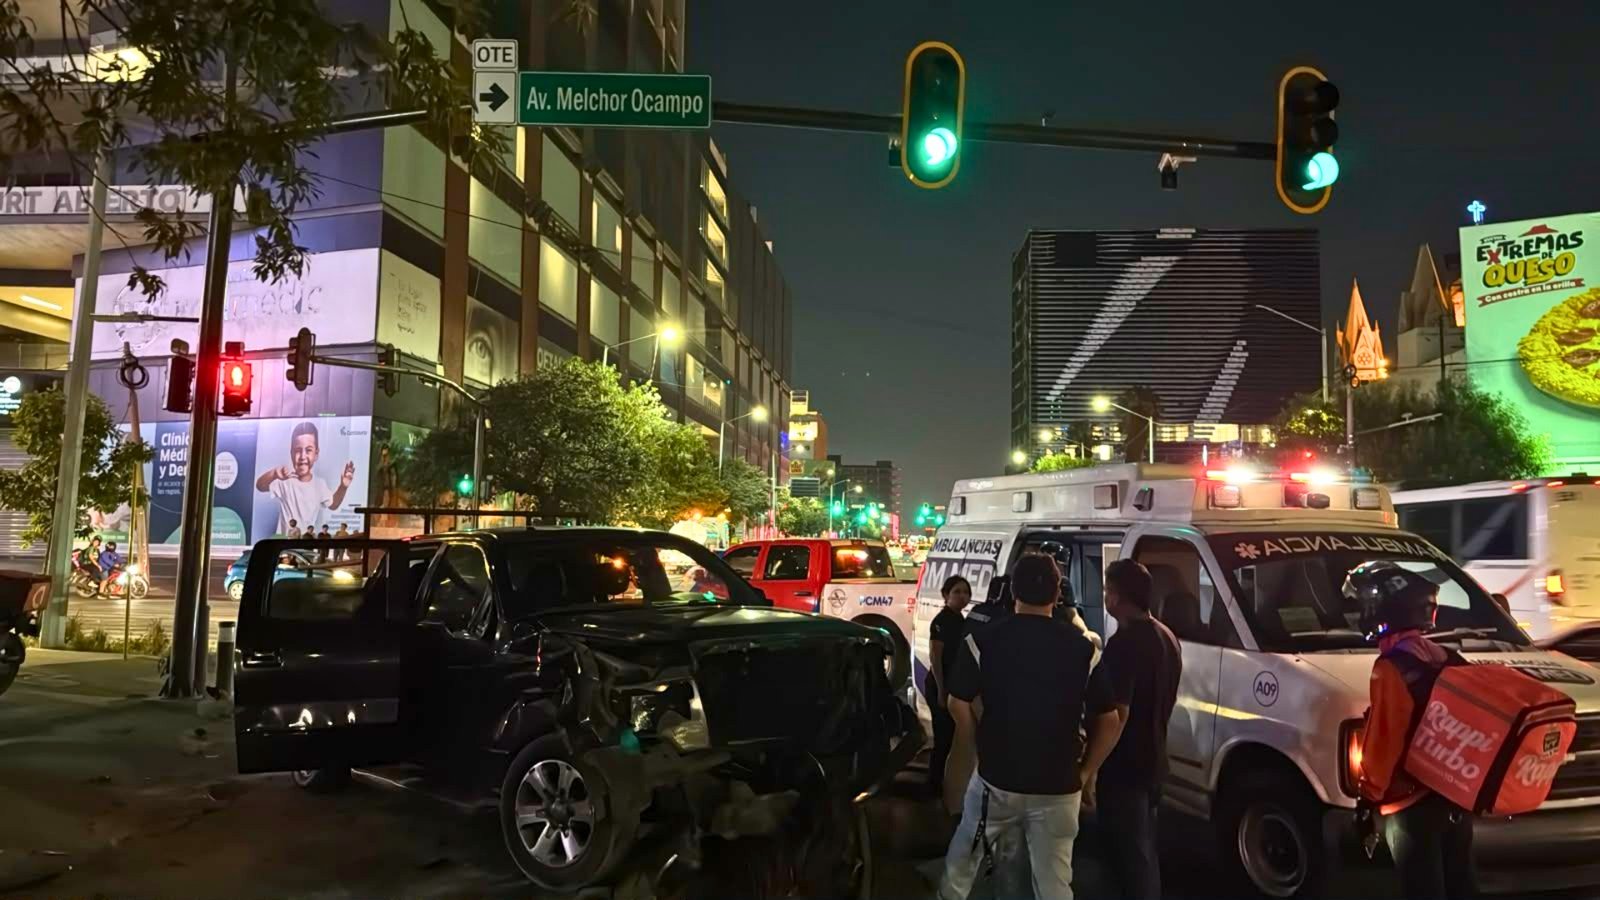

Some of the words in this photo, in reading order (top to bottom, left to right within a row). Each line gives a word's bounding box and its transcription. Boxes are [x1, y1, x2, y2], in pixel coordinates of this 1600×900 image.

[477, 46, 513, 64] OTE
[526, 86, 551, 111] Av.
[556, 87, 628, 113] Melchor
[631, 88, 704, 118] Ocampo
[0, 190, 42, 213] RT
[53, 189, 181, 213] ABERTO
[1476, 231, 1584, 265] EXTREMAS
[1541, 251, 1554, 260] DE
[1483, 251, 1576, 288] QUESO
[1485, 294, 1502, 303] Con
[1543, 282, 1552, 291] la
[161, 432, 191, 447] Clínic
[159, 448, 188, 462] Médi
[159, 466, 167, 479] y
[1255, 679, 1277, 698] A09
[1427, 701, 1498, 752] Rappi
[1415, 726, 1481, 779] Turbo
